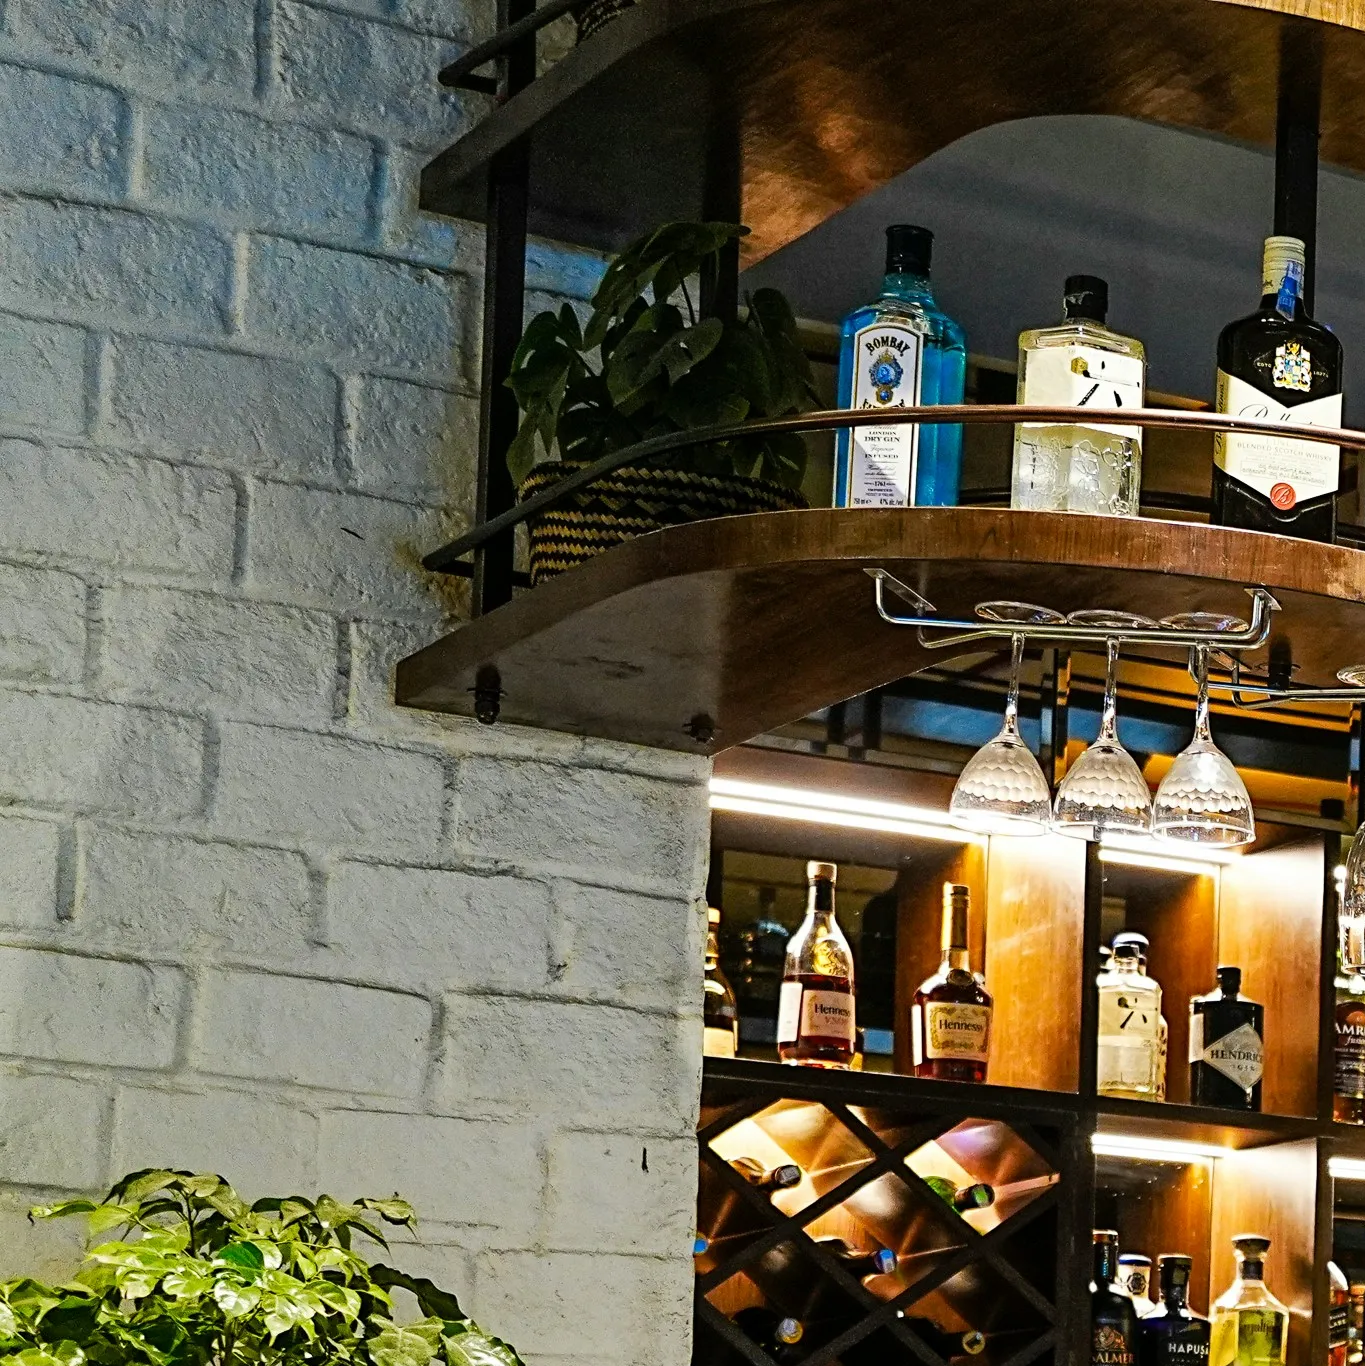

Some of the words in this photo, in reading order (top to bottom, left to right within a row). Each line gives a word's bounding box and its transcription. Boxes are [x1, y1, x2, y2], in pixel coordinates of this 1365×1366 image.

[865, 336, 911, 357] BOMBAY
[1237, 443, 1272, 452] BLENDED
[1274, 446, 1304, 457] SCOTCH
[1306, 451, 1332, 462] WHISKY
